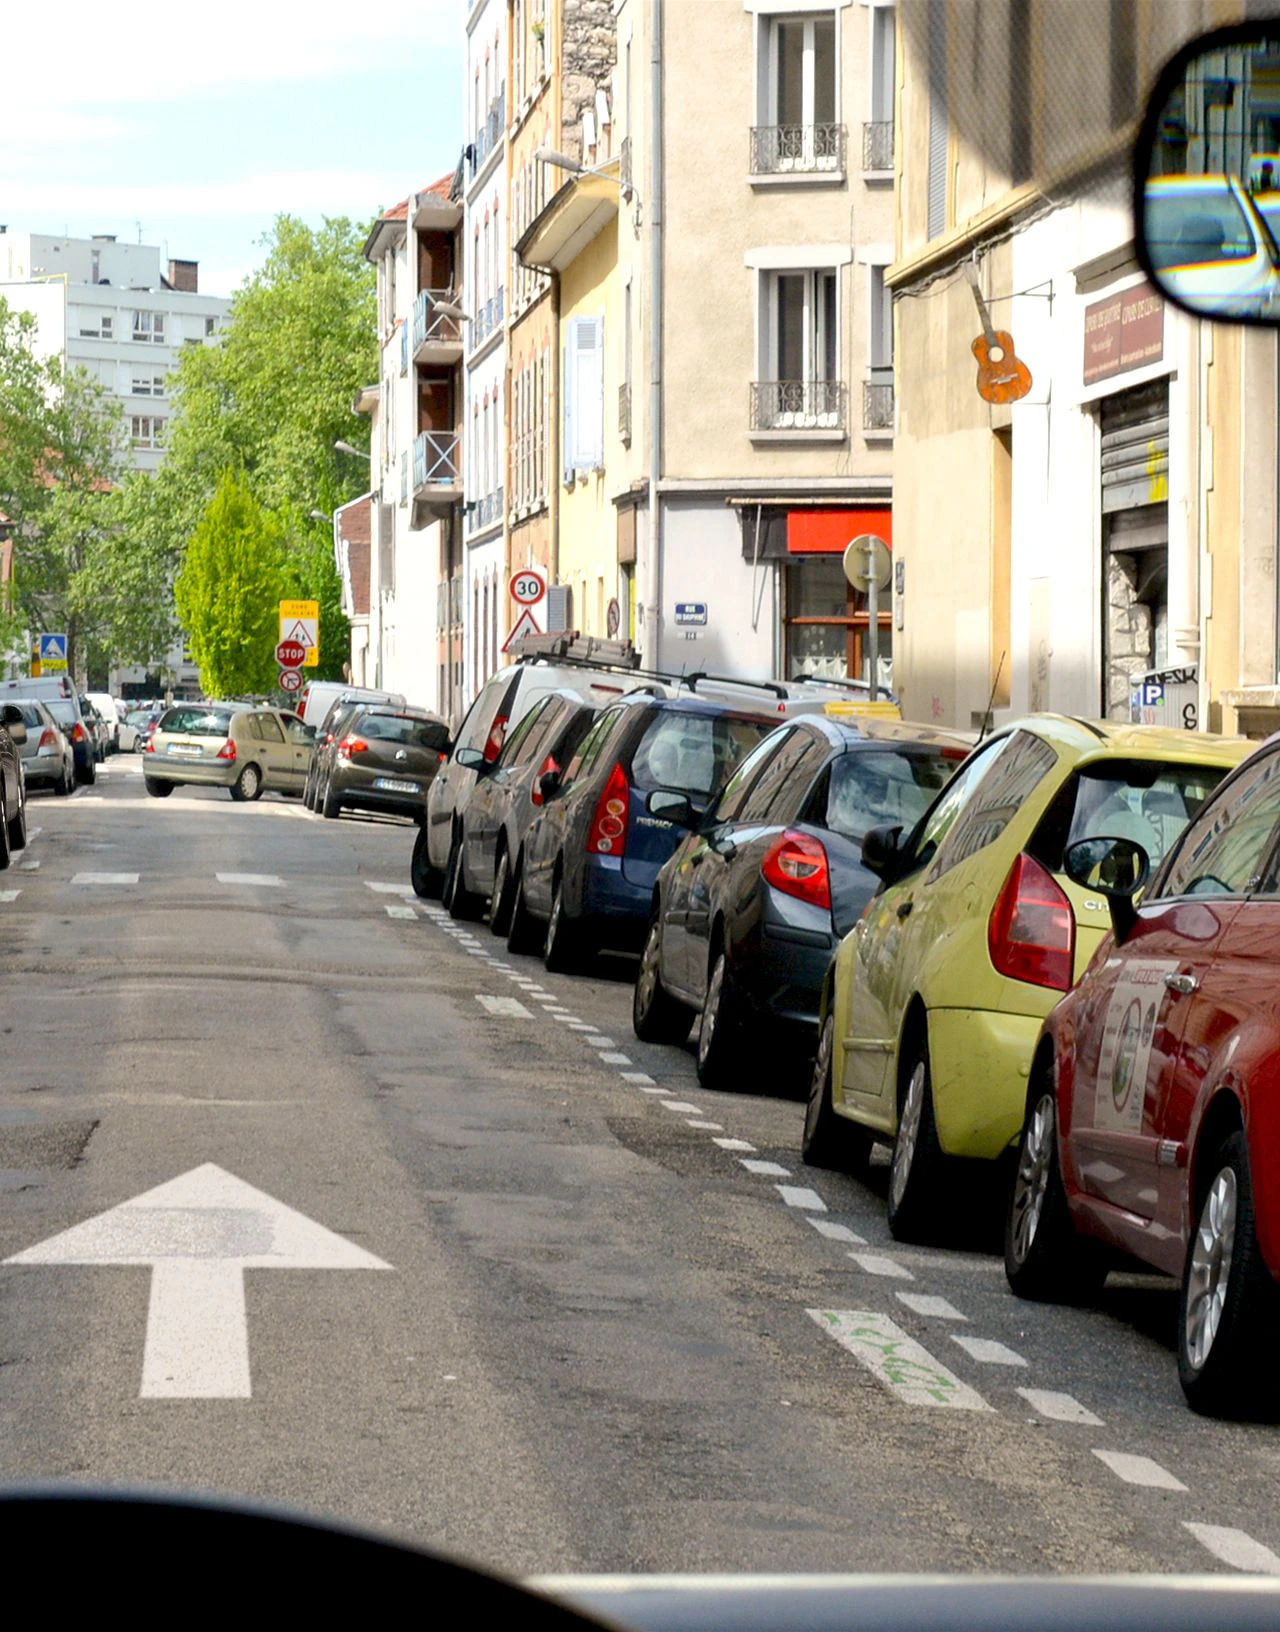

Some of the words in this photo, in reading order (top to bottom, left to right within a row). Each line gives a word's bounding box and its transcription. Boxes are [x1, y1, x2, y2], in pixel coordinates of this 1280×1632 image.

[517, 581, 539, 595] 30
[278, 648, 304, 660] STOP
[1146, 685, 1162, 704] P
